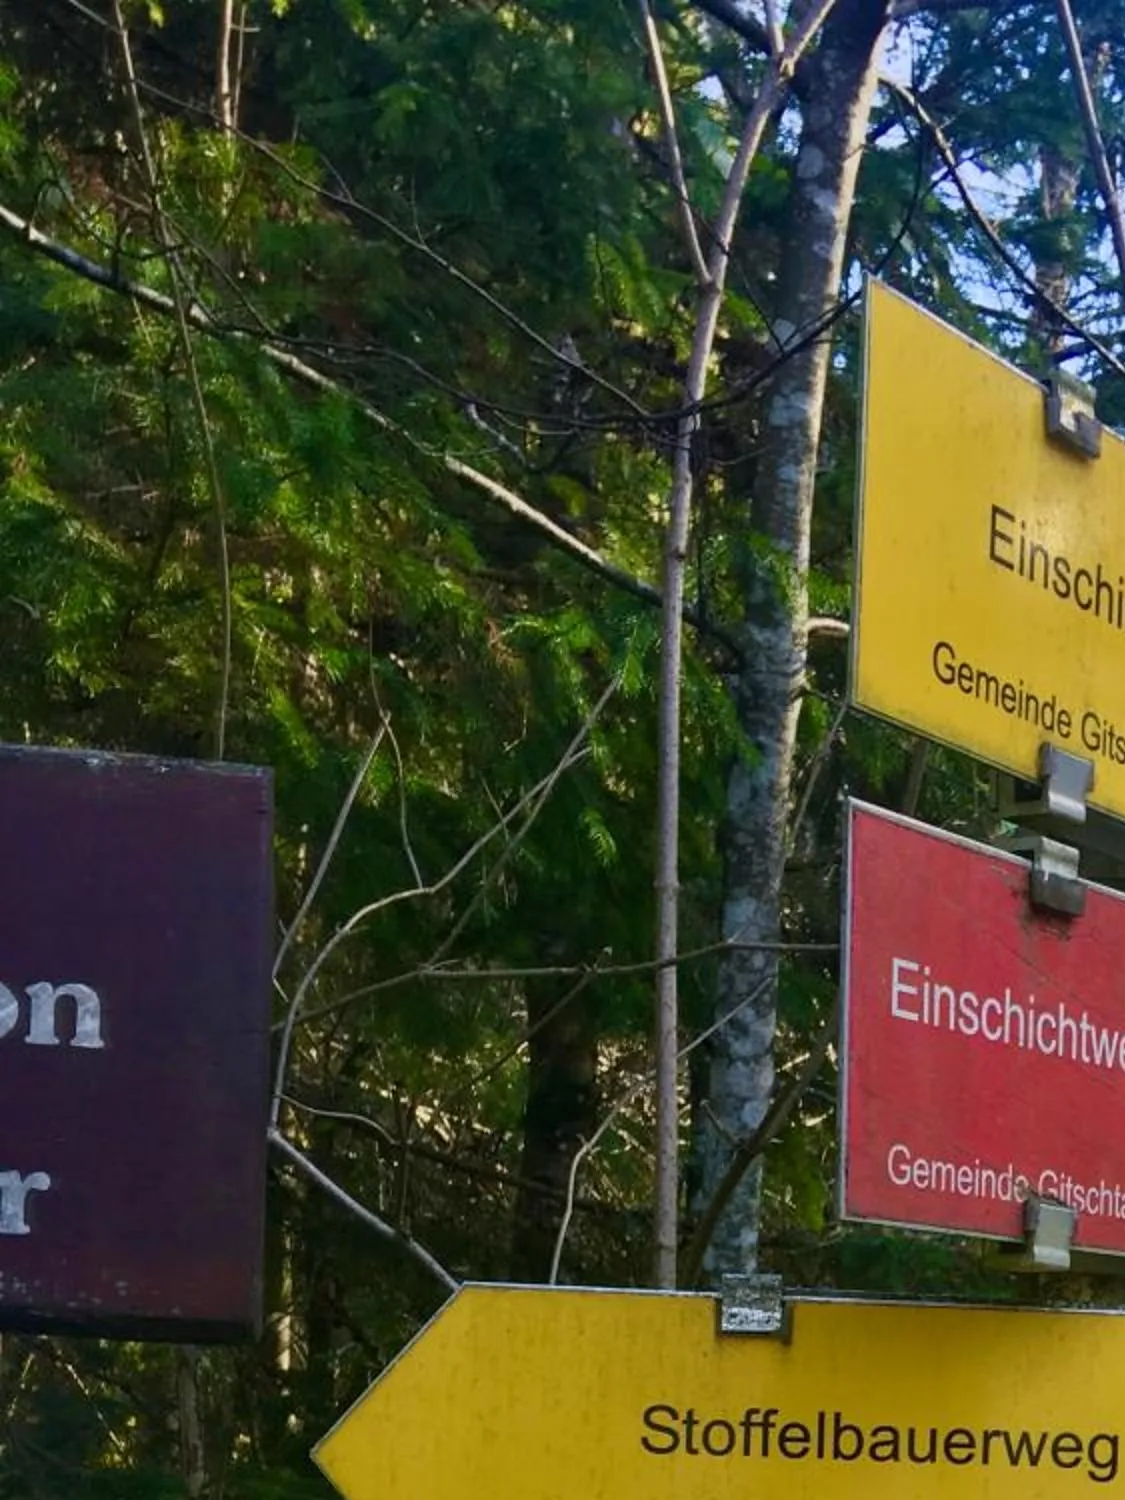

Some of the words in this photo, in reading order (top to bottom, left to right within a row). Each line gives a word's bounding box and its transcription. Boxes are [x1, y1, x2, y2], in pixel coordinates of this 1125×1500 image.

[932, 641, 1073, 740] Gemeinde
[887, 1144, 1029, 1203] Gemeinde
[640, 1403, 1120, 1483] Stoffelbauerweg
